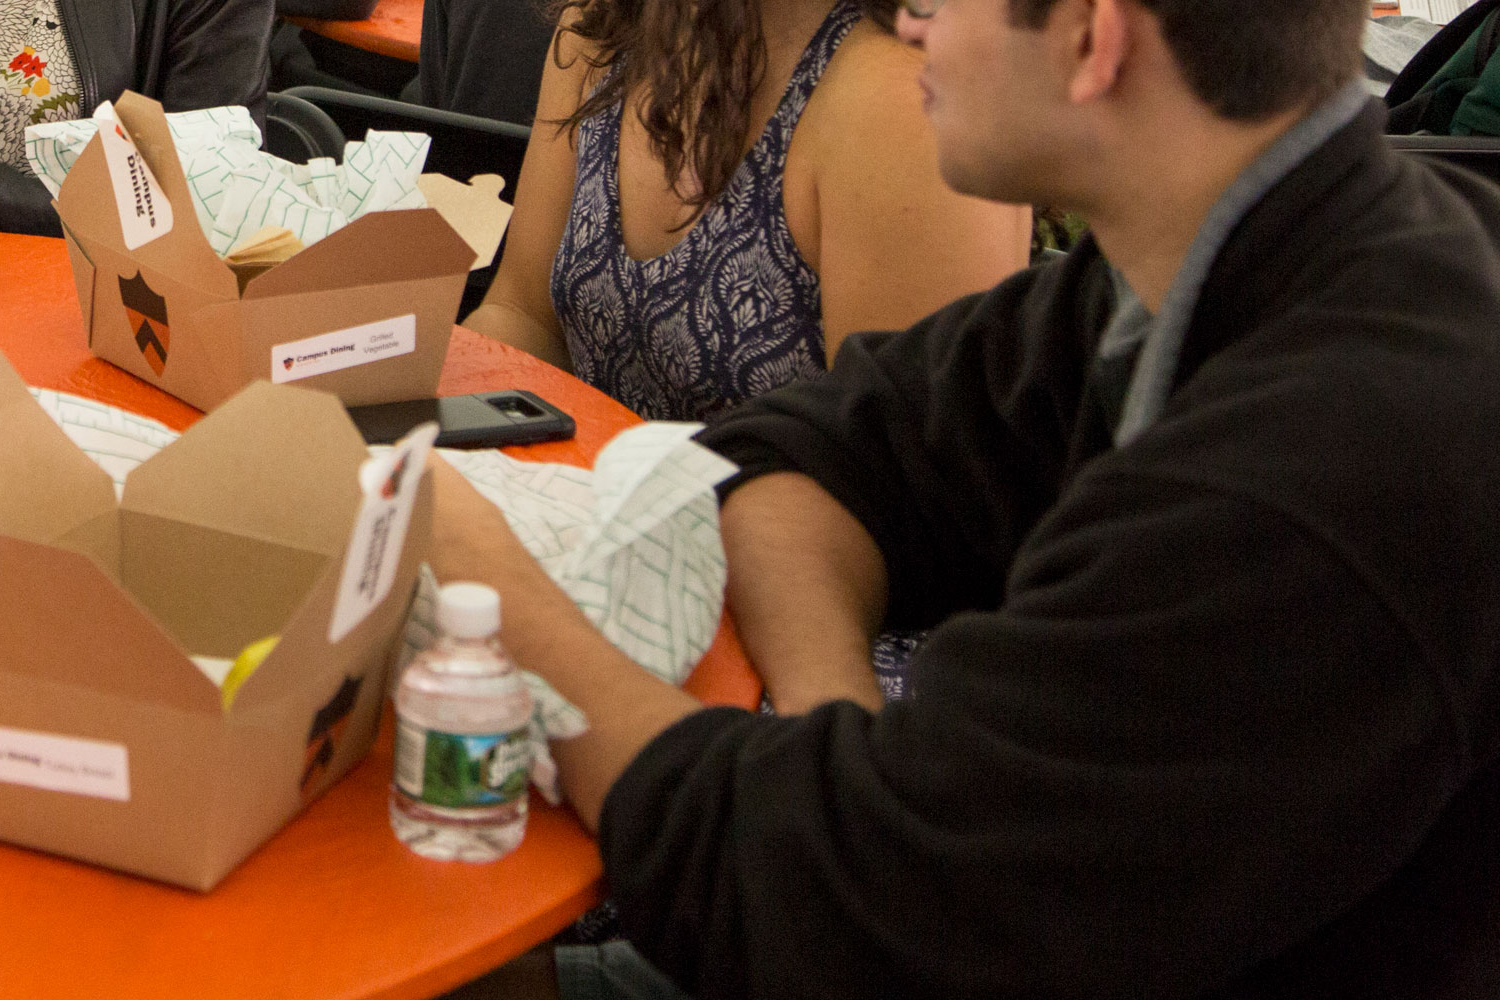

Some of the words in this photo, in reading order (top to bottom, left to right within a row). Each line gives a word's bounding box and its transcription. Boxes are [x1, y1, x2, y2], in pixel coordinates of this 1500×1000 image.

[127, 154, 146, 218] Dining
[296, 349, 328, 362] Campus
[329, 342, 357, 356] Dining
